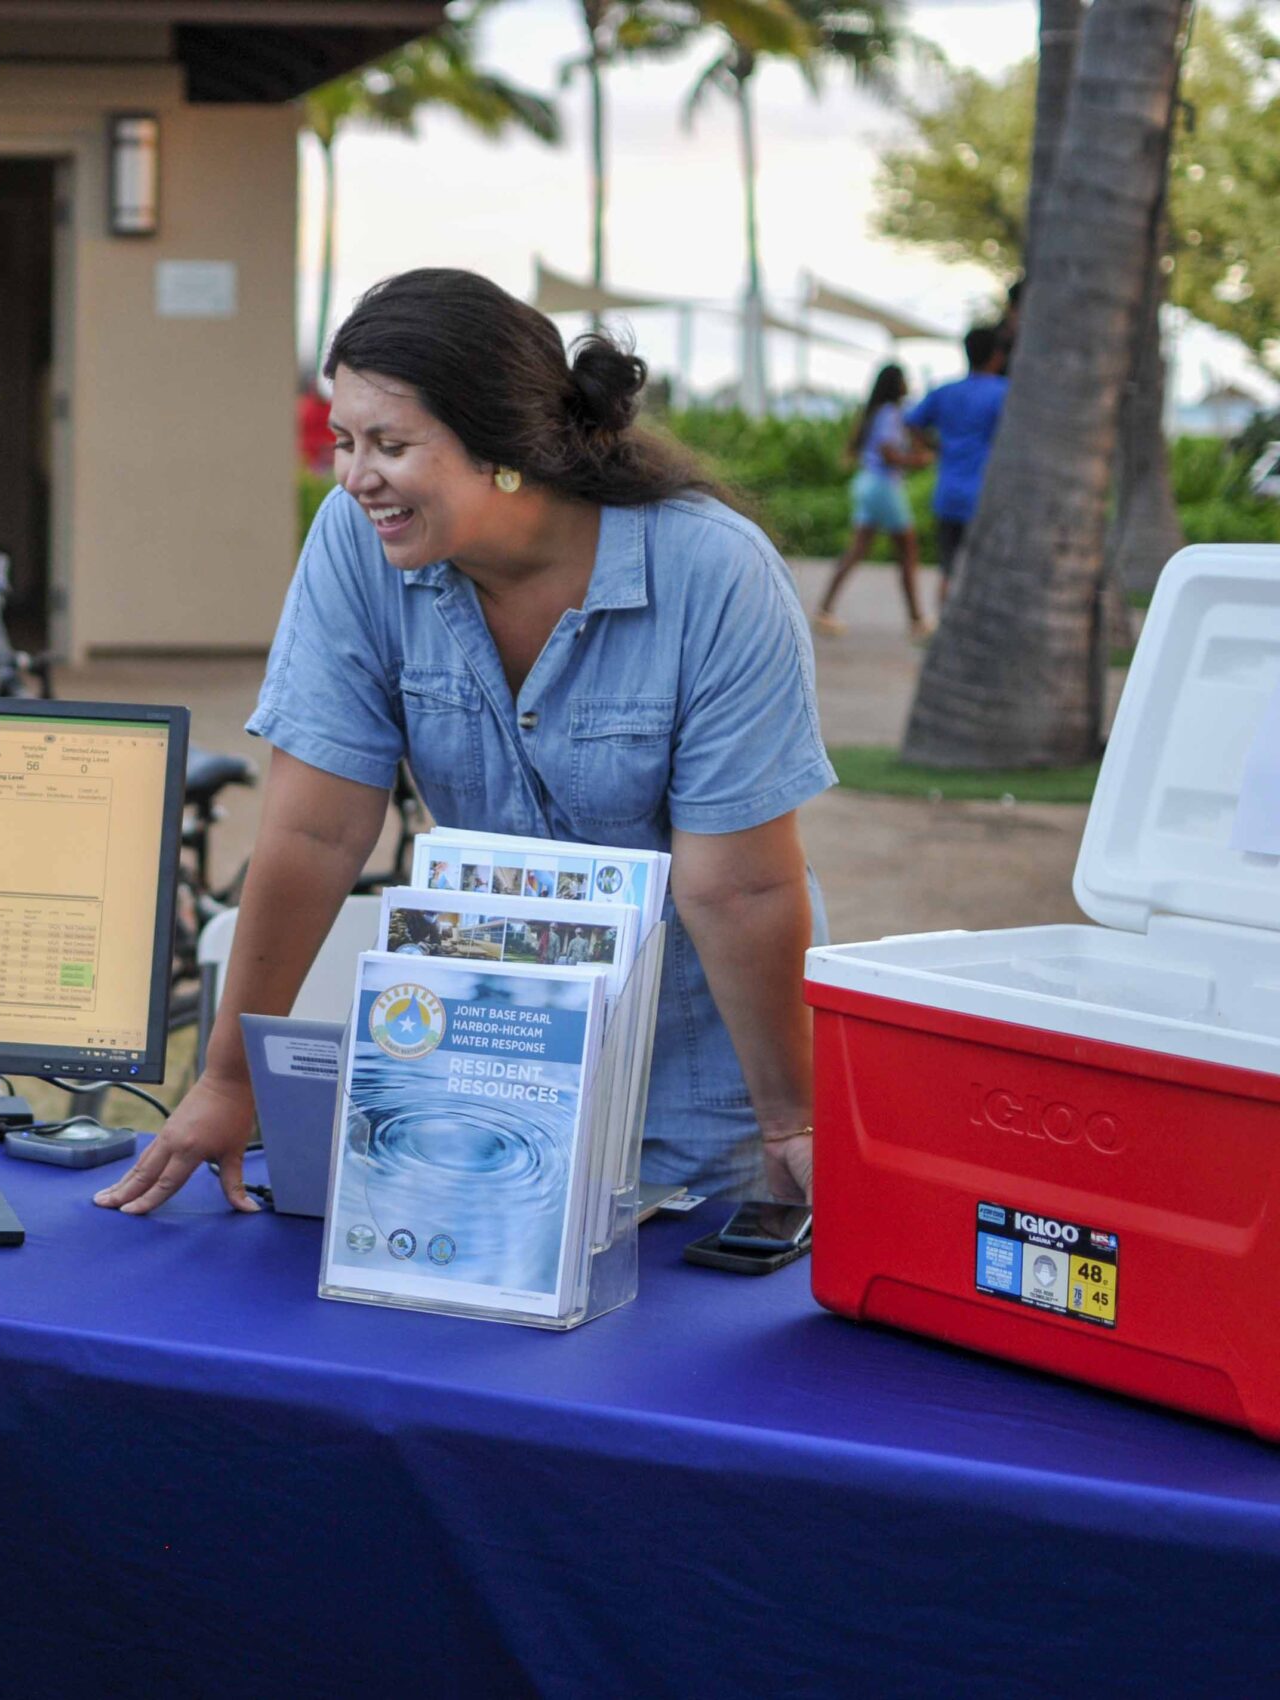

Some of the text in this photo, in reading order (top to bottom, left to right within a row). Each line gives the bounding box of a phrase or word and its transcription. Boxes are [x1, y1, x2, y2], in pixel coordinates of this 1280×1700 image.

[26, 761, 39, 771] 56
[81, 765, 87, 774] 0
[454, 1005, 552, 1025] JOINT BASE PEARL
[453, 1020, 543, 1038] HARBOR-HICKAM
[451, 1034, 546, 1054] WATER RESPONSE
[450, 1058, 543, 1081] RESIDENT
[447, 1078, 559, 1104] RESOURCES
[969, 1082, 1127, 1155] IGLOO
[1015, 1212, 1079, 1243] IGLOO
[1078, 1263, 1102, 1283] 48
[1074, 1288, 1082, 1299] 76
[1092, 1292, 1108, 1305] 45
